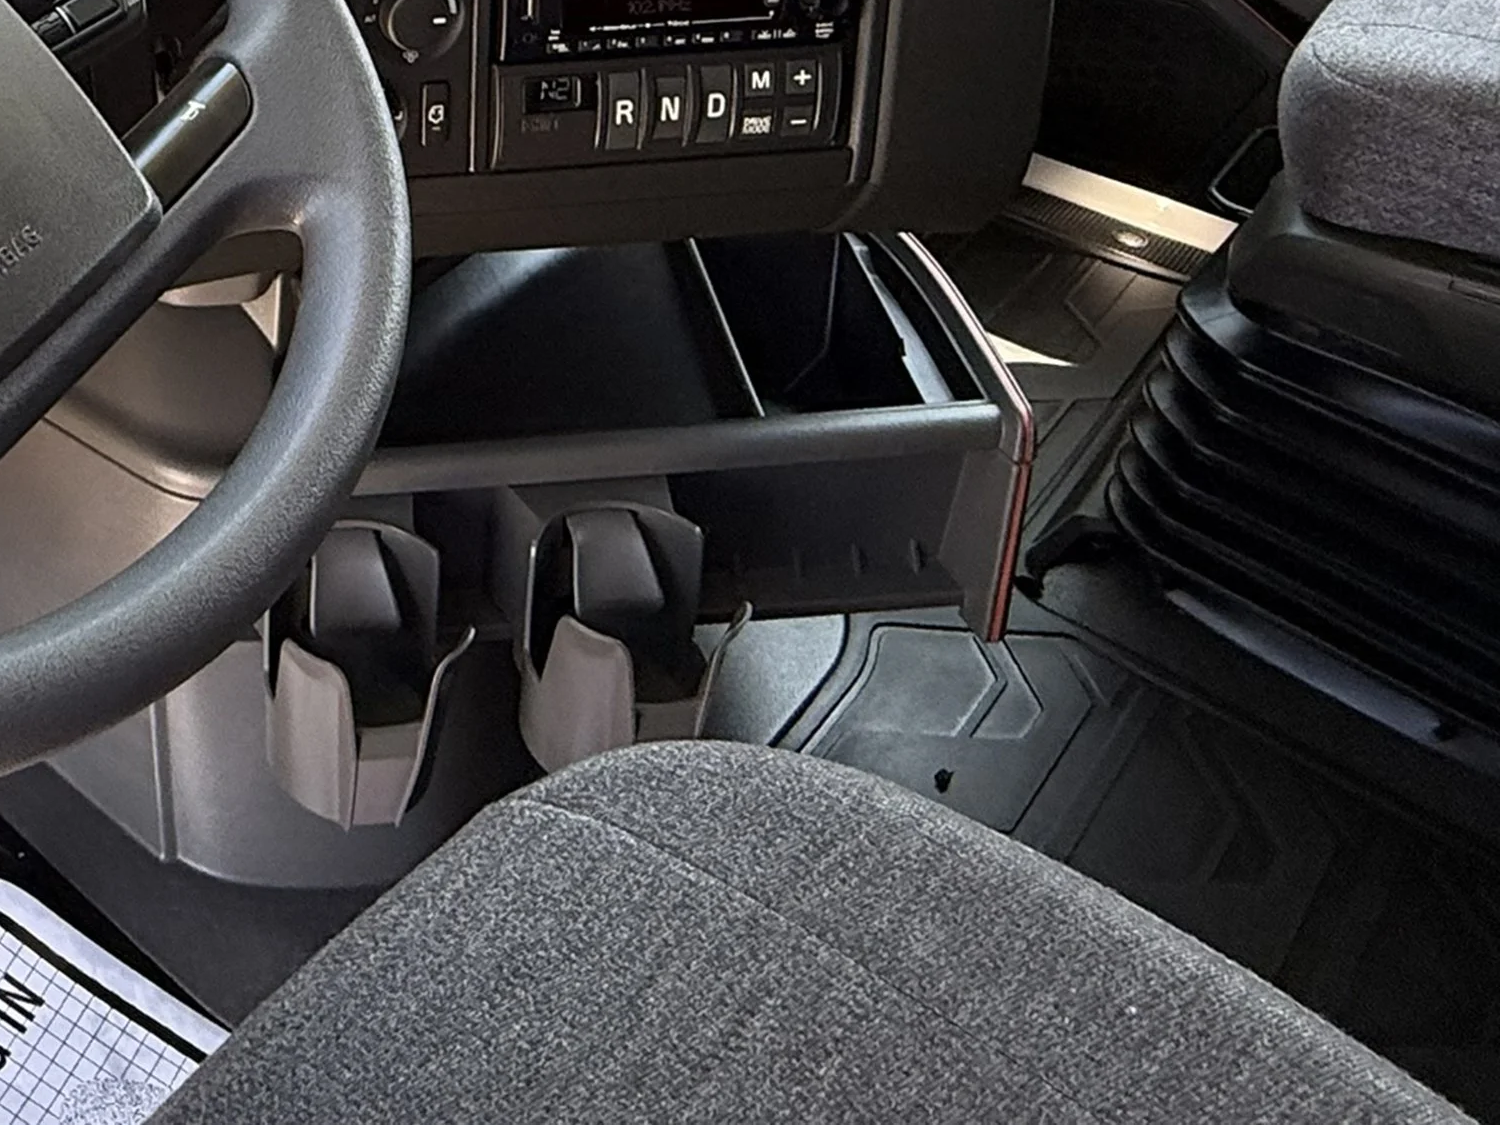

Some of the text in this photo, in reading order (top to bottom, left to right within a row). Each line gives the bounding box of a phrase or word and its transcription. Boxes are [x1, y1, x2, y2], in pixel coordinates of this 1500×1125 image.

[751, 70, 771, 89] M
[615, 99, 634, 126] R
[659, 96, 680, 122] N
[707, 92, 727, 118] D
